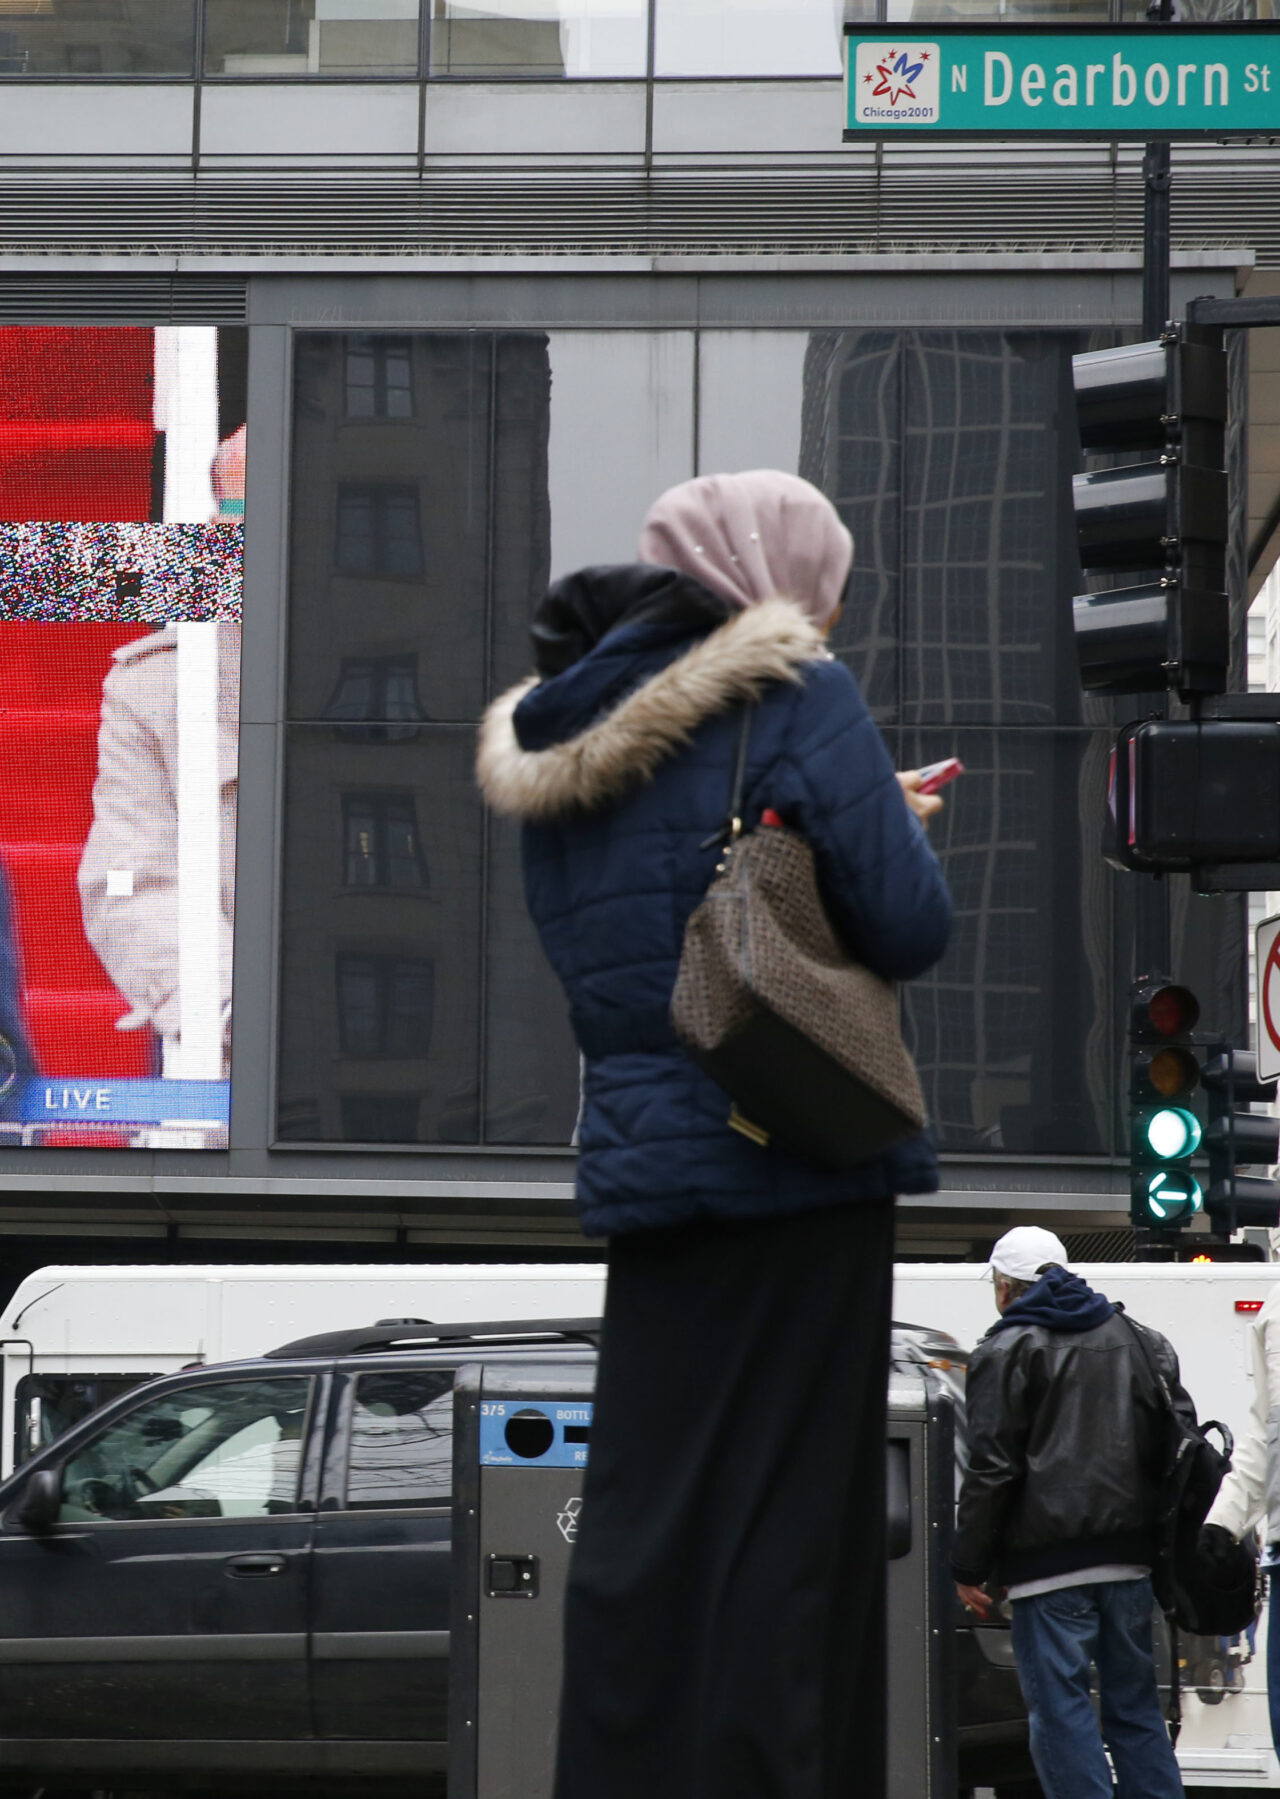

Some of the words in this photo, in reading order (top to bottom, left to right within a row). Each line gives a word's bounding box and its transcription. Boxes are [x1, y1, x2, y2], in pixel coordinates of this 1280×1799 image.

[951, 65, 967, 93] N
[984, 51, 1229, 106] Dearborn
[1244, 63, 1271, 93] St
[863, 107, 934, 120] Chicago2001
[45, 1088, 112, 1110] LIVE
[556, 1410, 592, 1420] BOTTL
